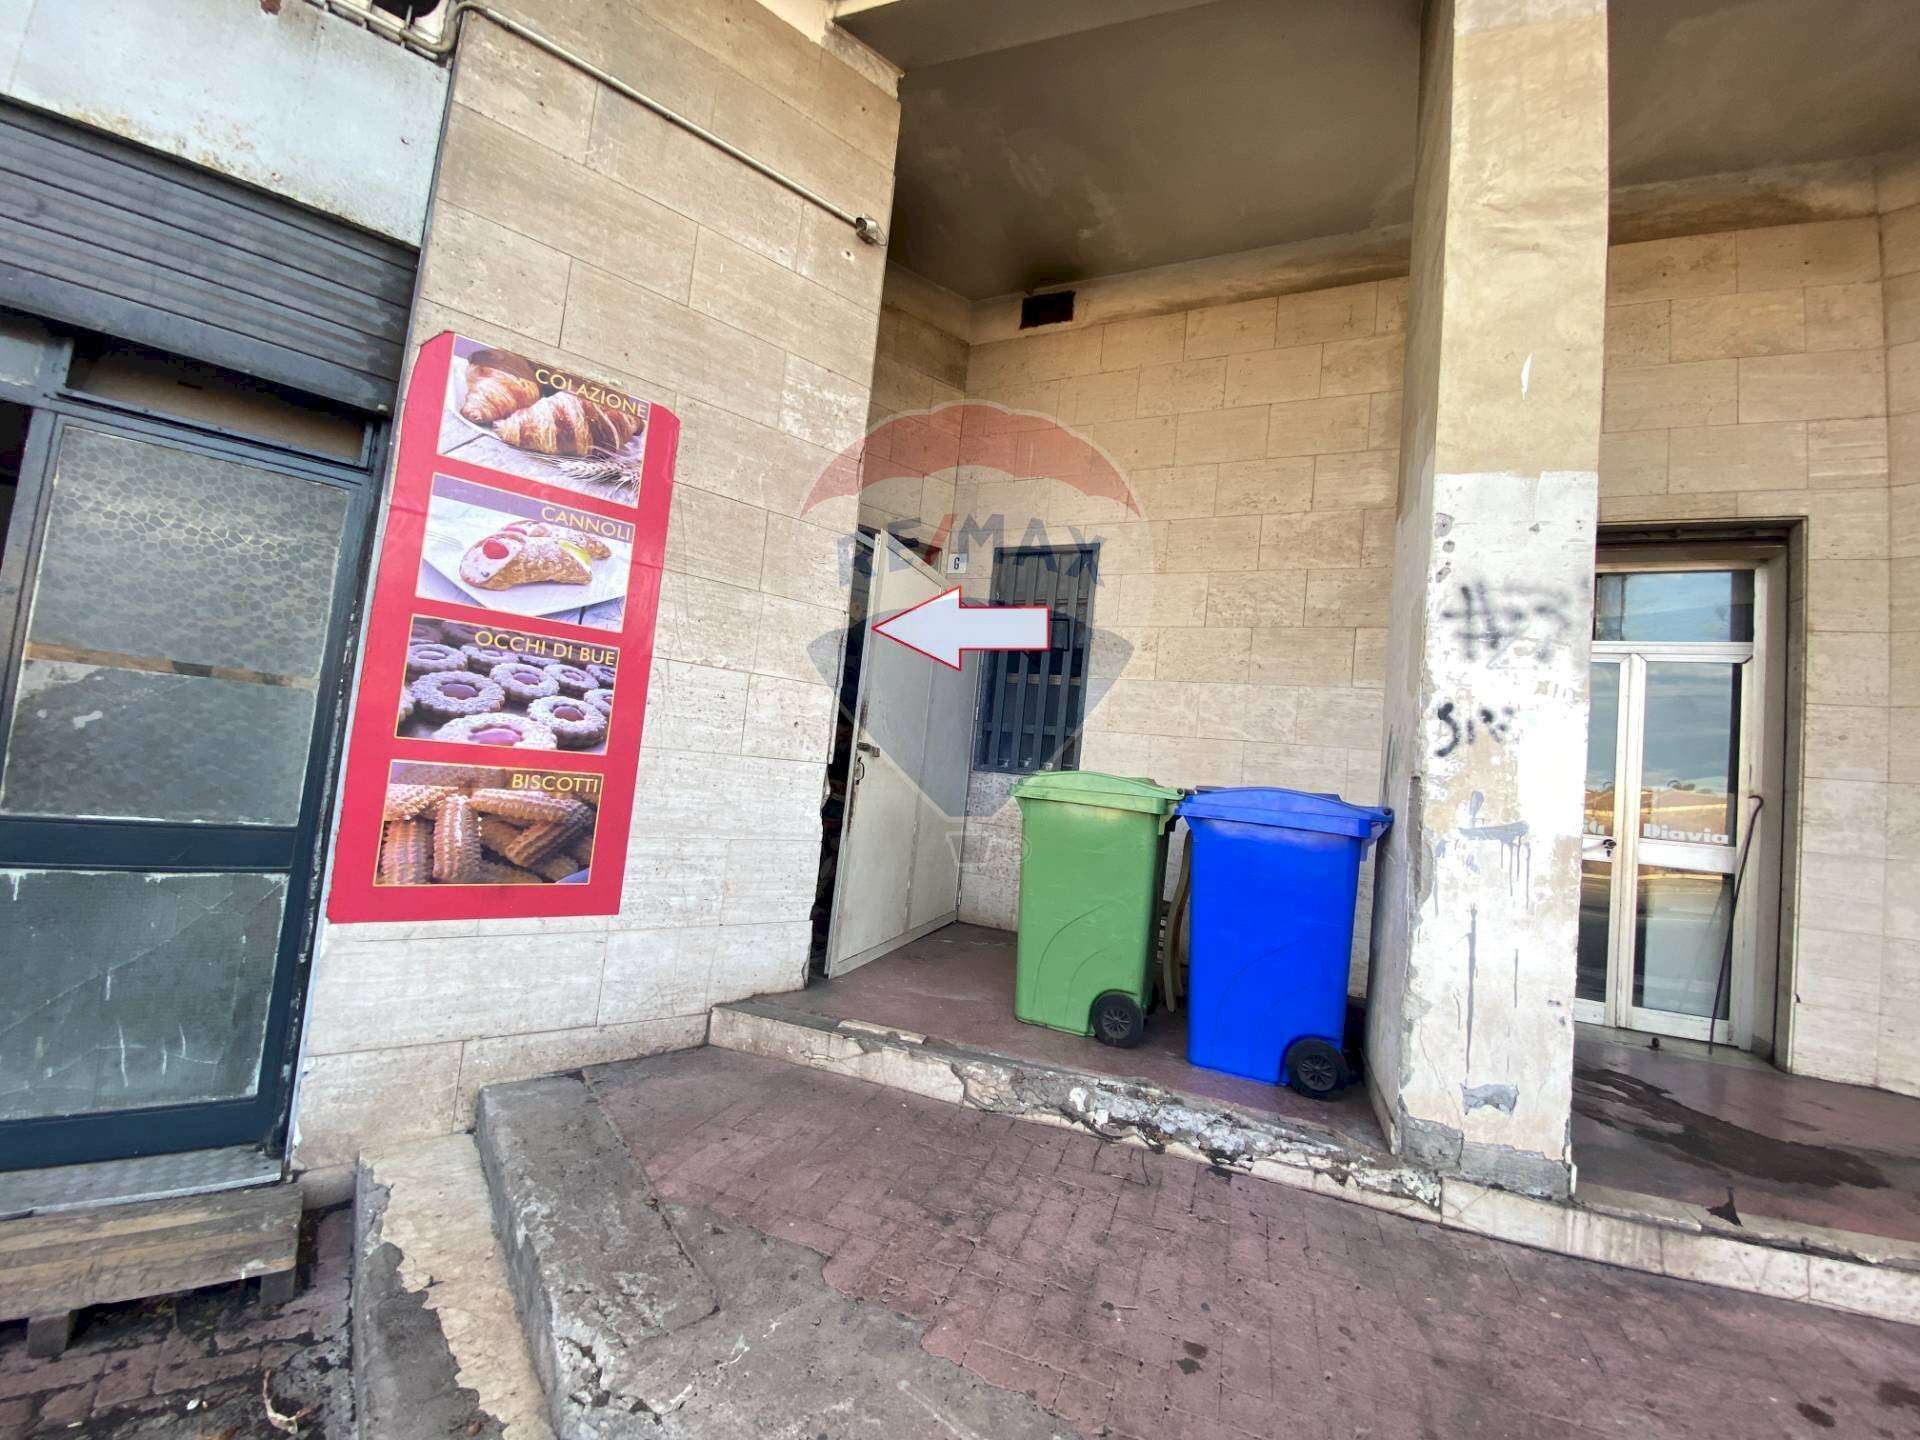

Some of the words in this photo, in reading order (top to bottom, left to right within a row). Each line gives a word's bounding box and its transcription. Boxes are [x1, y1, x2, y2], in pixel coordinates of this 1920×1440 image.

[535, 369, 647, 418] COLAZIONE
[542, 507, 631, 539] CANNOLI
[475, 631, 545, 655] OCCHI
[553, 643, 573, 659] DI
[580, 648, 616, 665] BUE
[512, 774, 598, 793] BISCOTTI
[1643, 823, 1729, 844] Diavia
